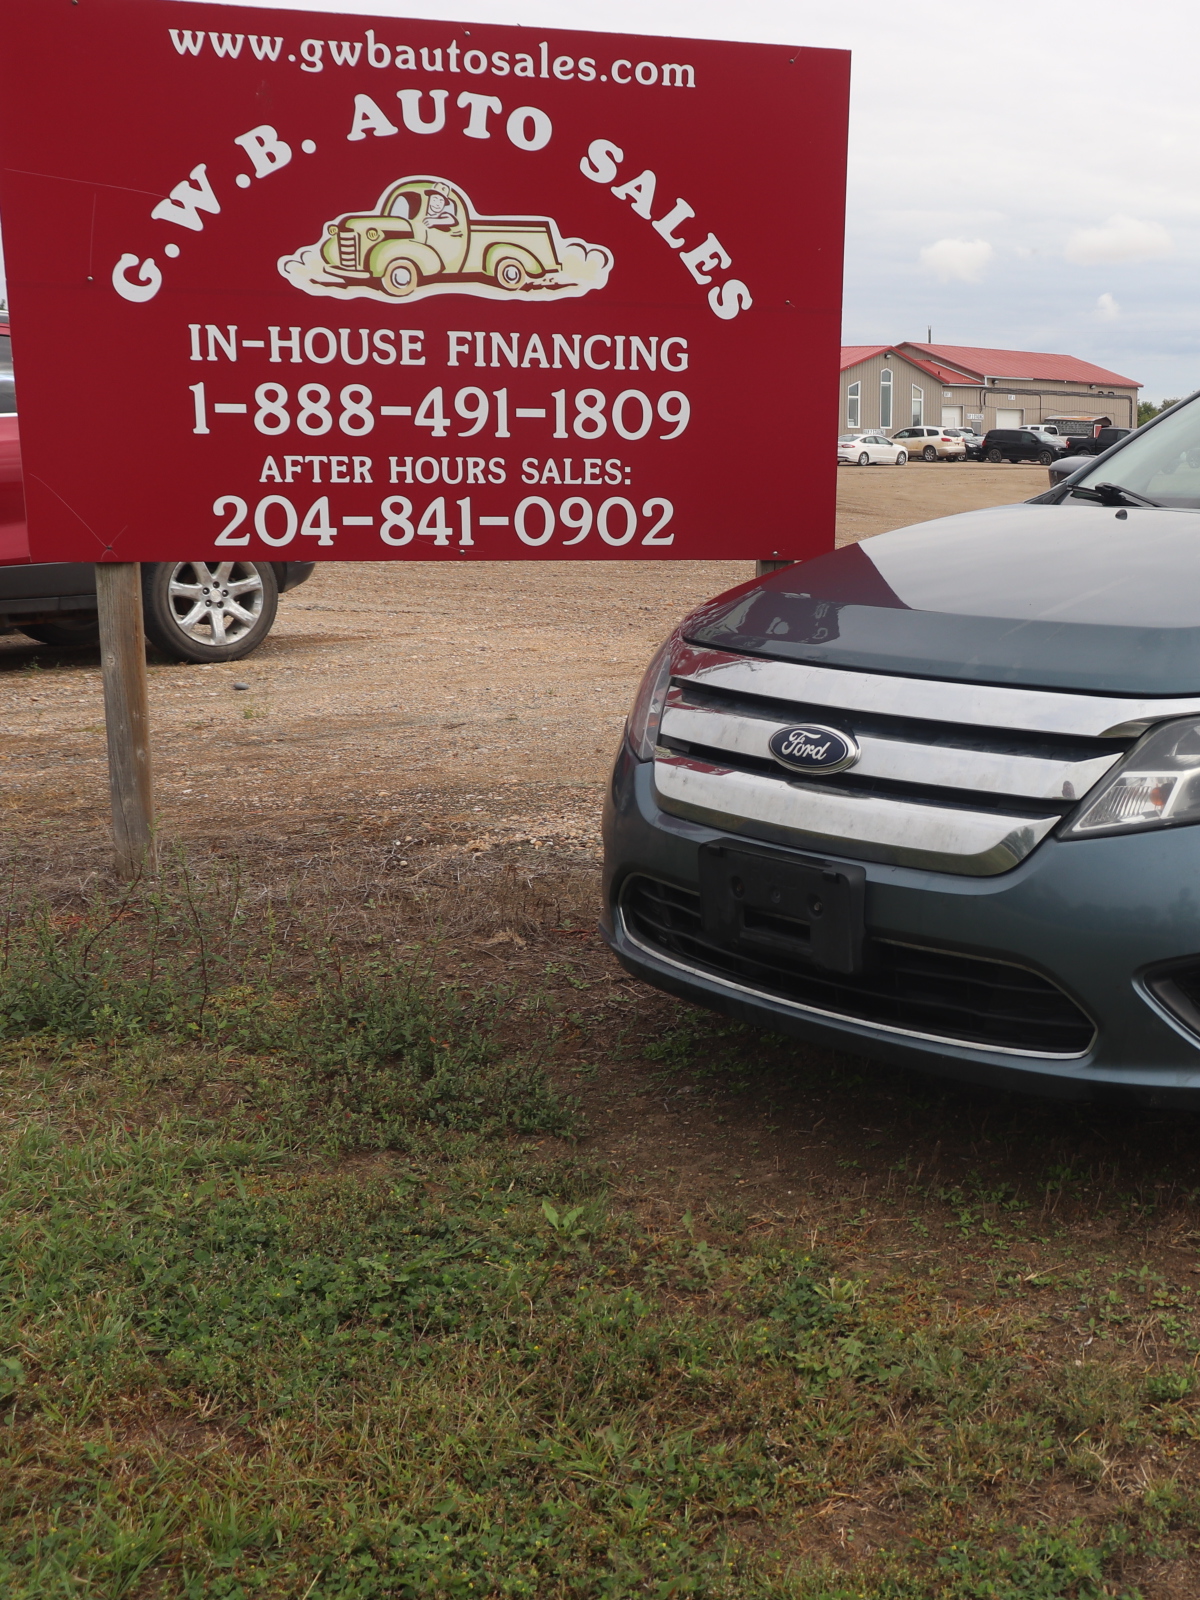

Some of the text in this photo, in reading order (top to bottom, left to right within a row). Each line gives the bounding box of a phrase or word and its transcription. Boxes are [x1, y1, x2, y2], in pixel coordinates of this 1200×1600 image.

[168, 28, 697, 89] www.gwbautosales.com
[111, 88, 753, 320] G.W.B. AUTO SALES
[188, 324, 690, 373] IN-HOUSE FINANCING
[189, 381, 691, 441] 1-888-491-1809
[258, 455, 633, 486] AFTER HOURS SALES:
[212, 494, 675, 548] 204-841-0902
[781, 730, 831, 760] Ford
